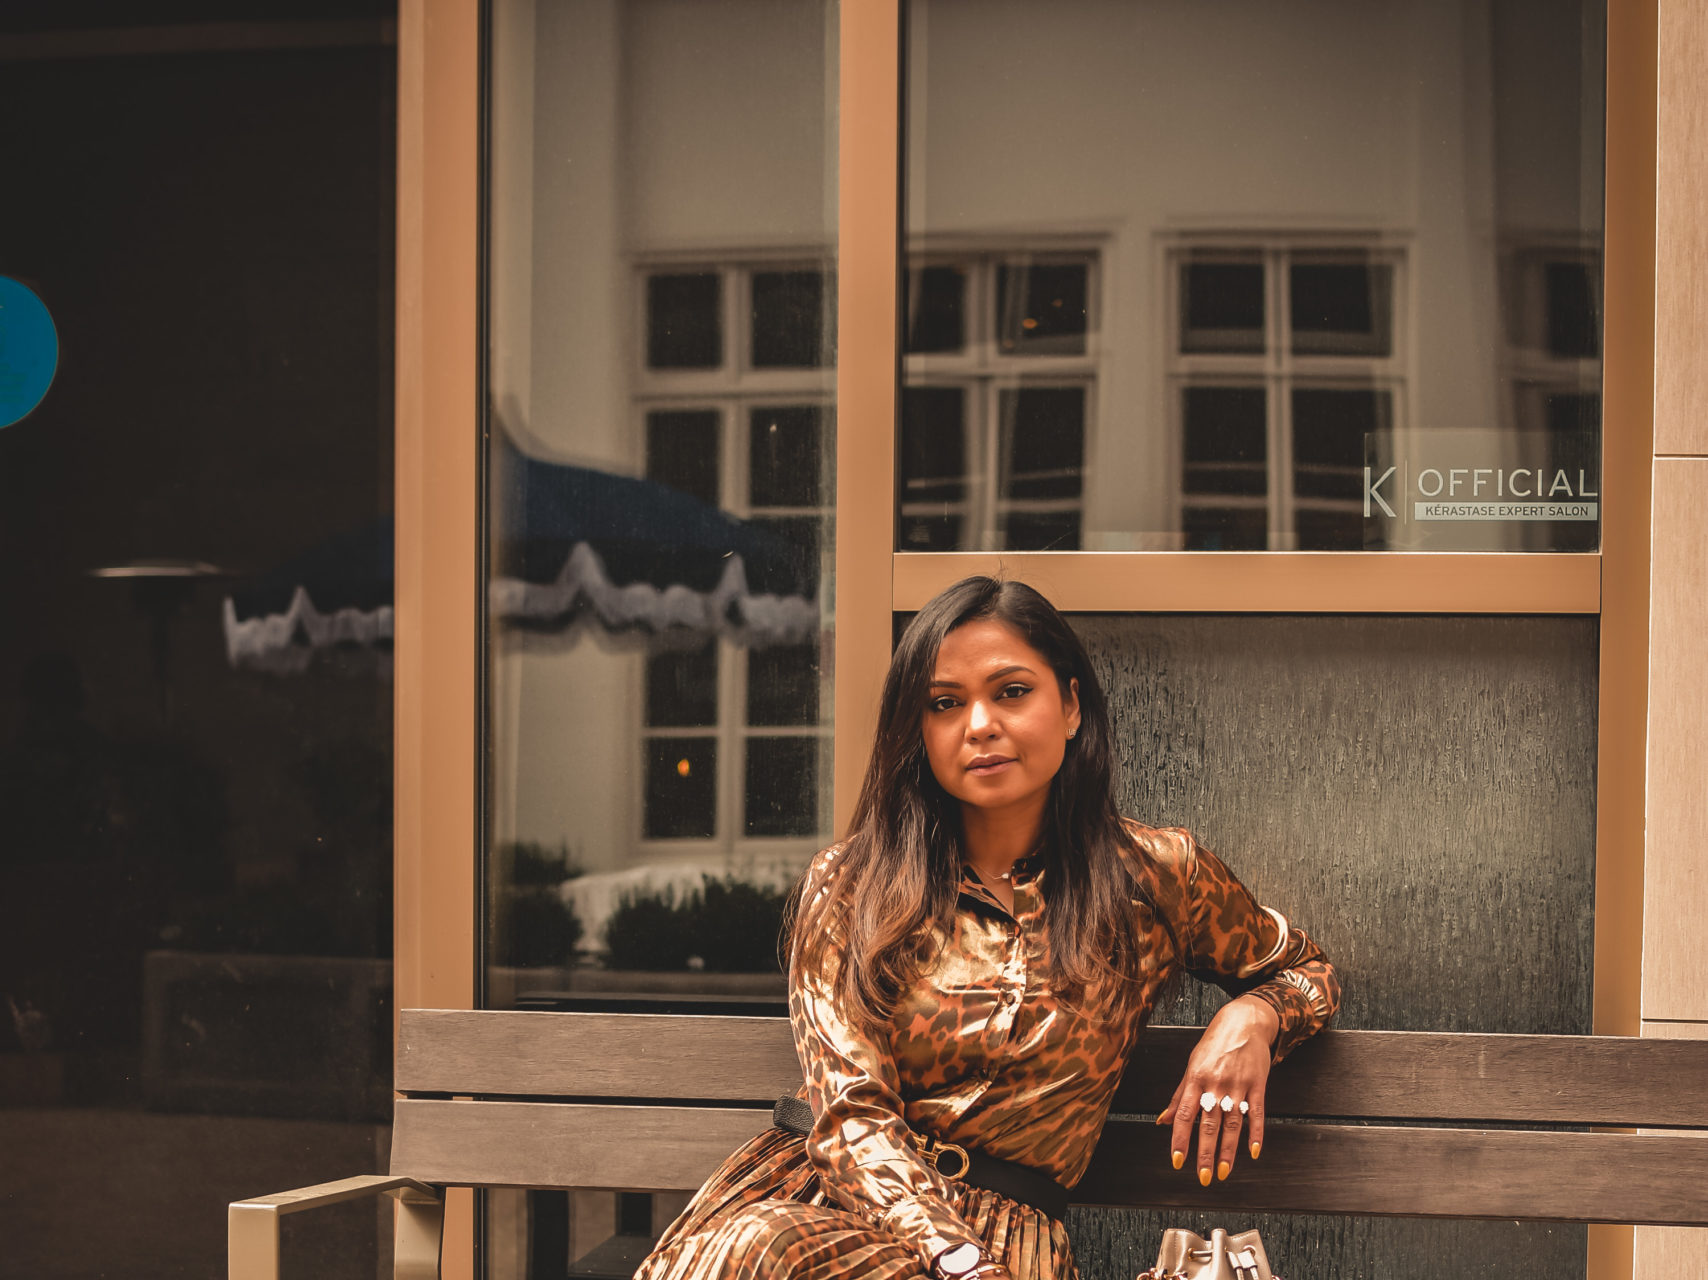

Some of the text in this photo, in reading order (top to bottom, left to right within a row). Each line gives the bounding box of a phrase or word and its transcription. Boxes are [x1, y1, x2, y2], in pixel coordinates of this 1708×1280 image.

[1363, 466, 1397, 518] K
[1418, 468, 1599, 497] OFFICIAL
[1425, 504, 1589, 516] KÉRASTASE EXPERT SALON
